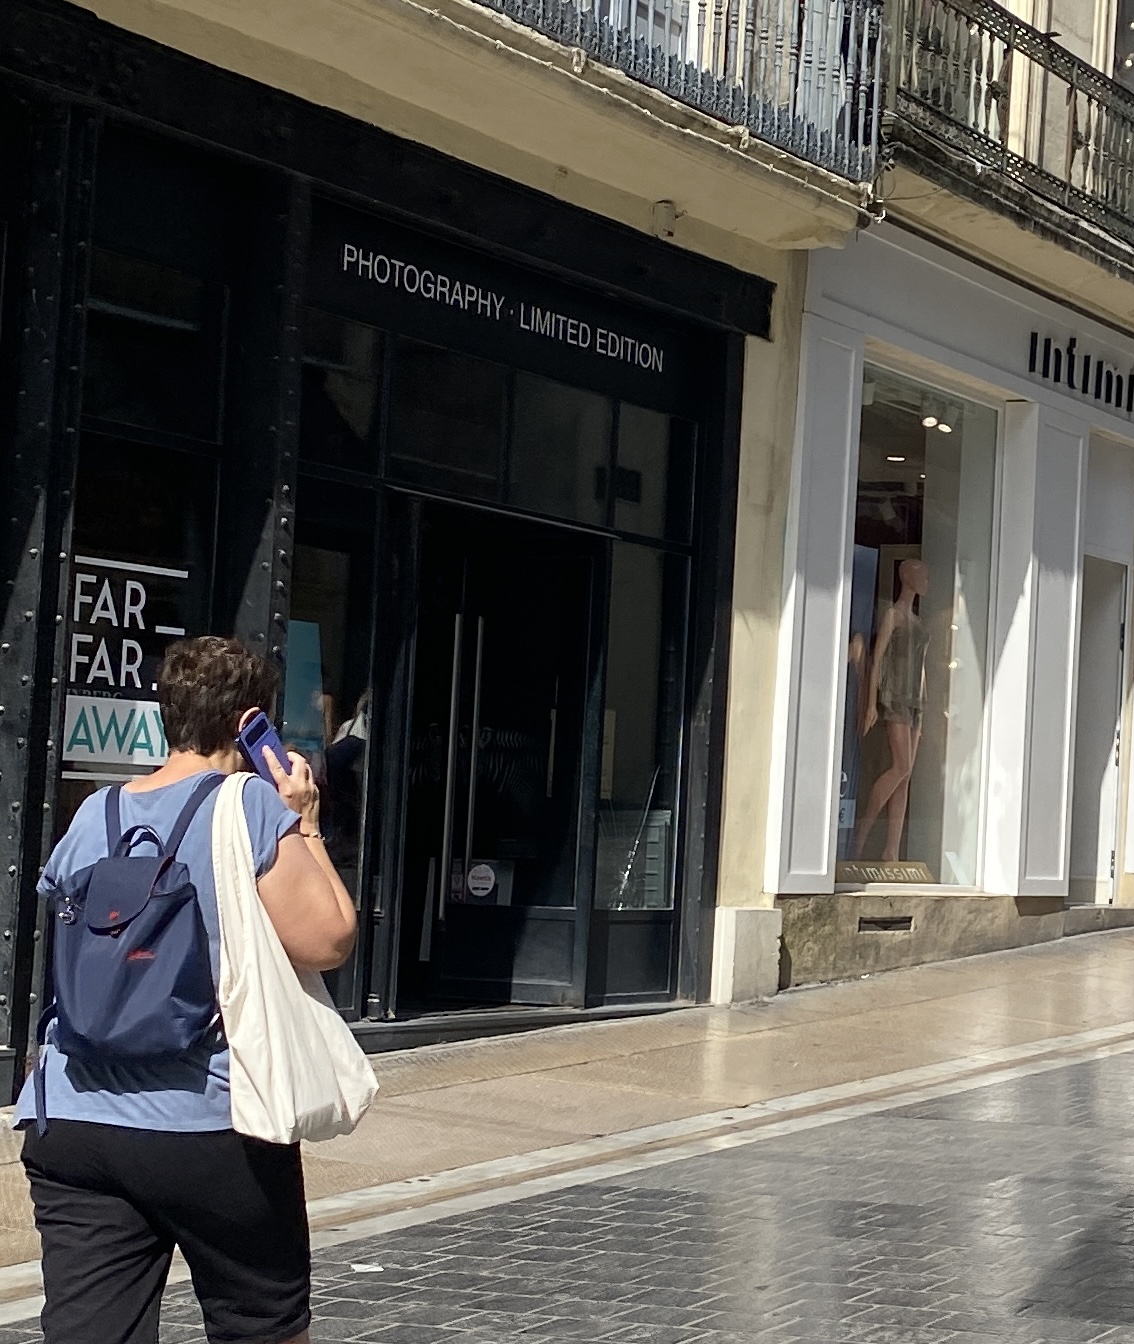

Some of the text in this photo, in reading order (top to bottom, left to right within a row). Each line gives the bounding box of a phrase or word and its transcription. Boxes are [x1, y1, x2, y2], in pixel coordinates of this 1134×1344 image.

[343, 243, 664, 373] PHOTOGRAPHY LIMITED EDITION
[73, 572, 147, 630] FAR
[69, 632, 143, 689] FAR
